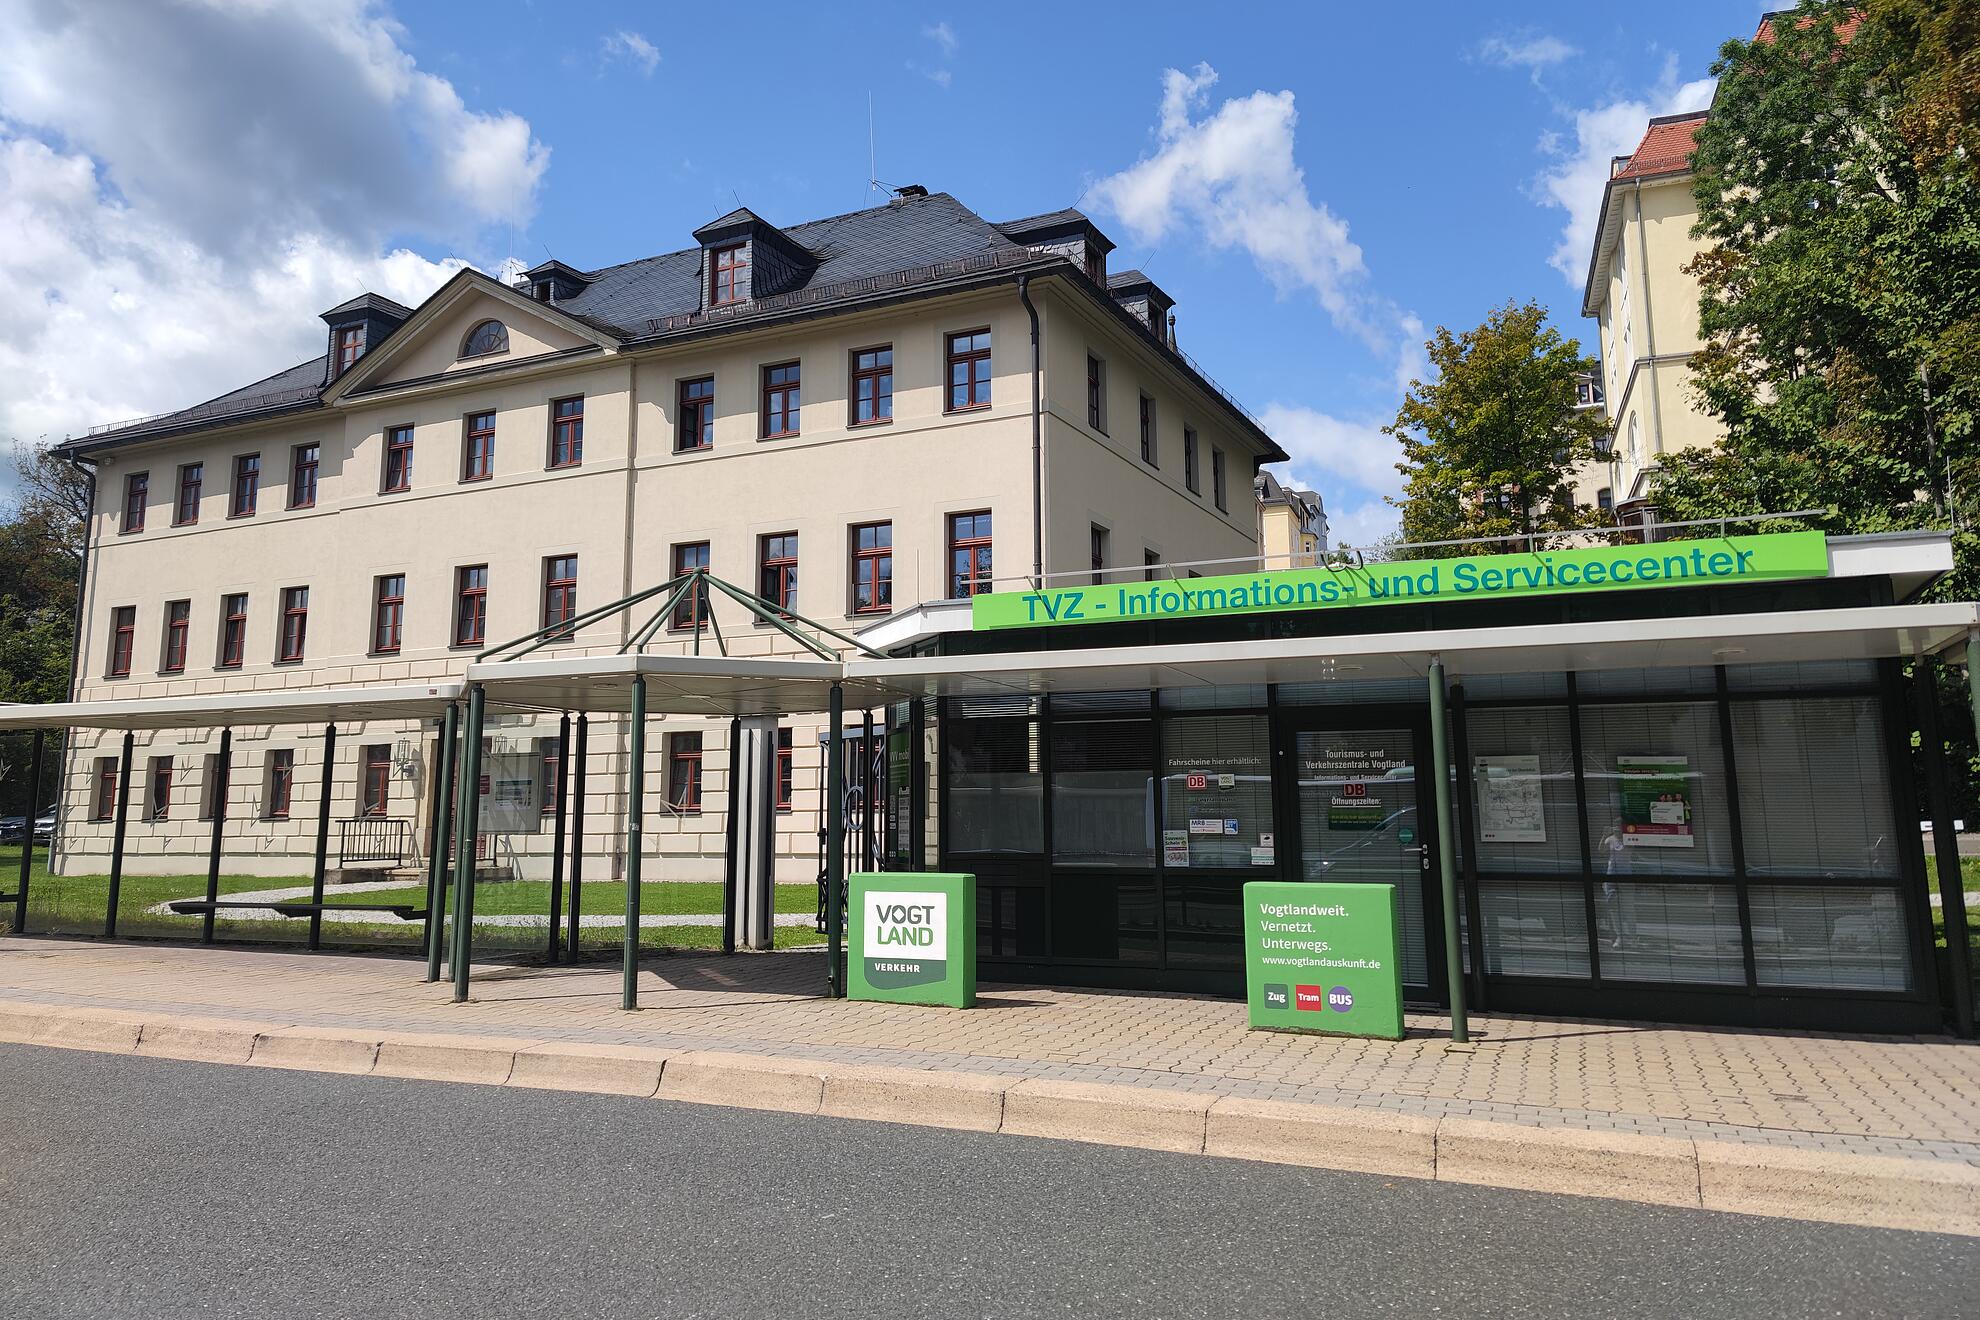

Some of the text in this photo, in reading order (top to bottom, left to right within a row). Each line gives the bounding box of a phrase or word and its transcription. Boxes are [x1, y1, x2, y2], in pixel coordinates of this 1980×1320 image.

[1022, 547, 1754, 622] TVZ - Informations- und Servicecenter
[1325, 749, 1384, 759] Tourismus- und
[1168, 757, 1211, 767] Fahrscheine
[1211, 757, 1226, 766] hier
[1305, 760, 1406, 770] Verkehrszentrale Vogtland
[1189, 777, 1205, 788] DB
[1344, 783, 1365, 796] DB
[875, 904, 936, 925] VOGT
[1260, 903, 1350, 918] Vogtlandweit.
[1260, 920, 1316, 933] Vernetzt.
[877, 926, 934, 947] LAND
[1262, 937, 1332, 953] Unterwegs.
[874, 962, 921, 973] VERKEHR
[1262, 956, 1382, 969] www.vogtlandauskunft.de
[1267, 991, 1353, 1006] Zug Tram BUS
